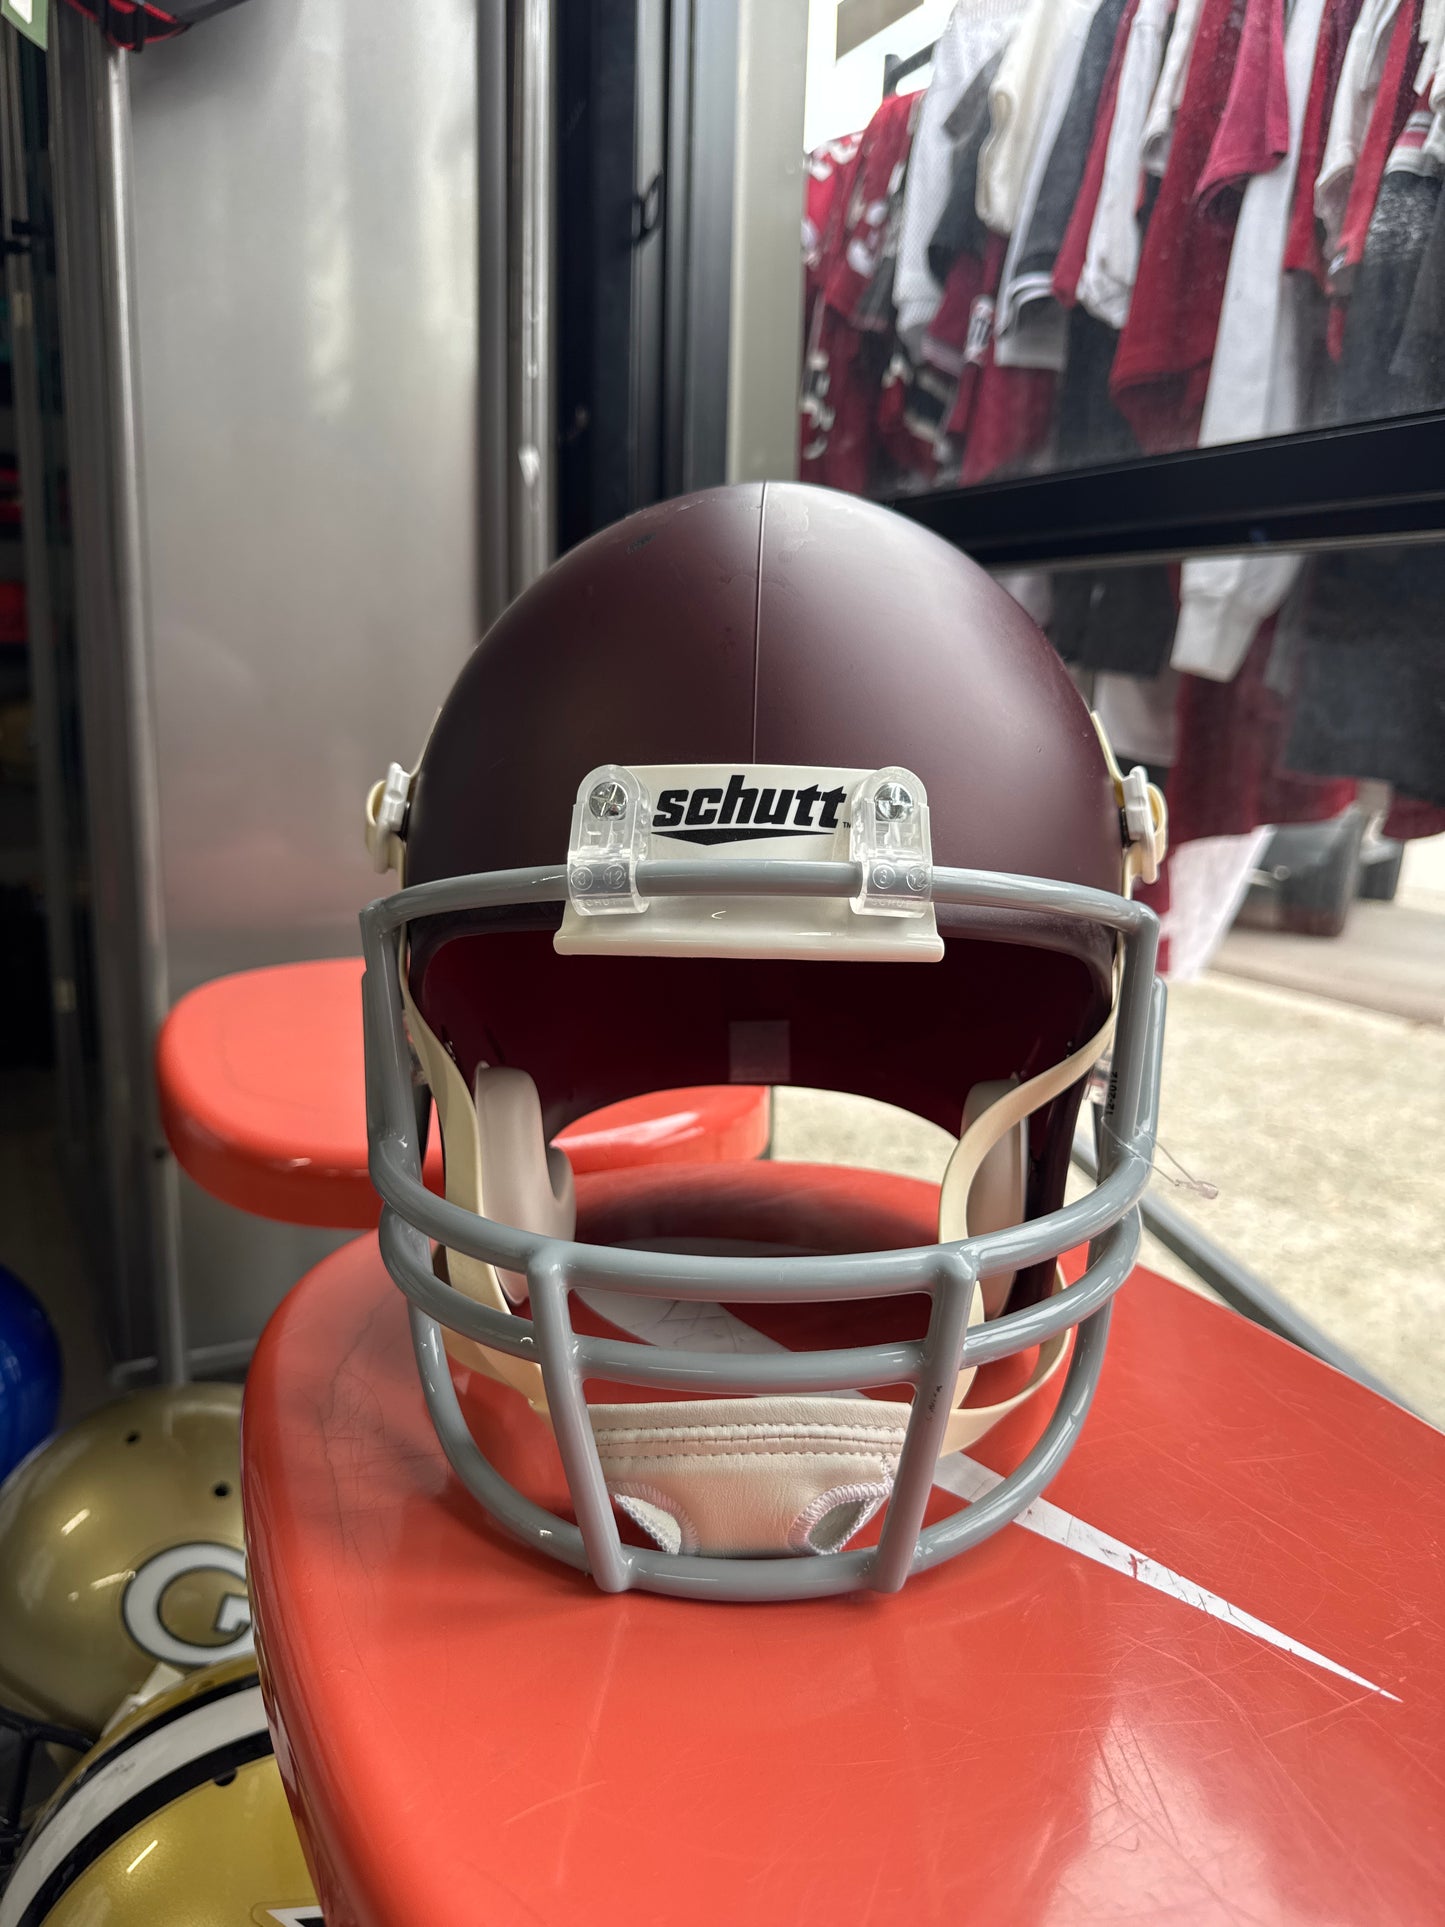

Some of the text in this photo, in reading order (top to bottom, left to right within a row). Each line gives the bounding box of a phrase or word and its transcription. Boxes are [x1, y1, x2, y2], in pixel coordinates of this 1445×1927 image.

[652, 775, 847, 829] schutt
[1105, 1071, 1118, 1116] 12-2012
[121, 1540, 256, 1669] G
